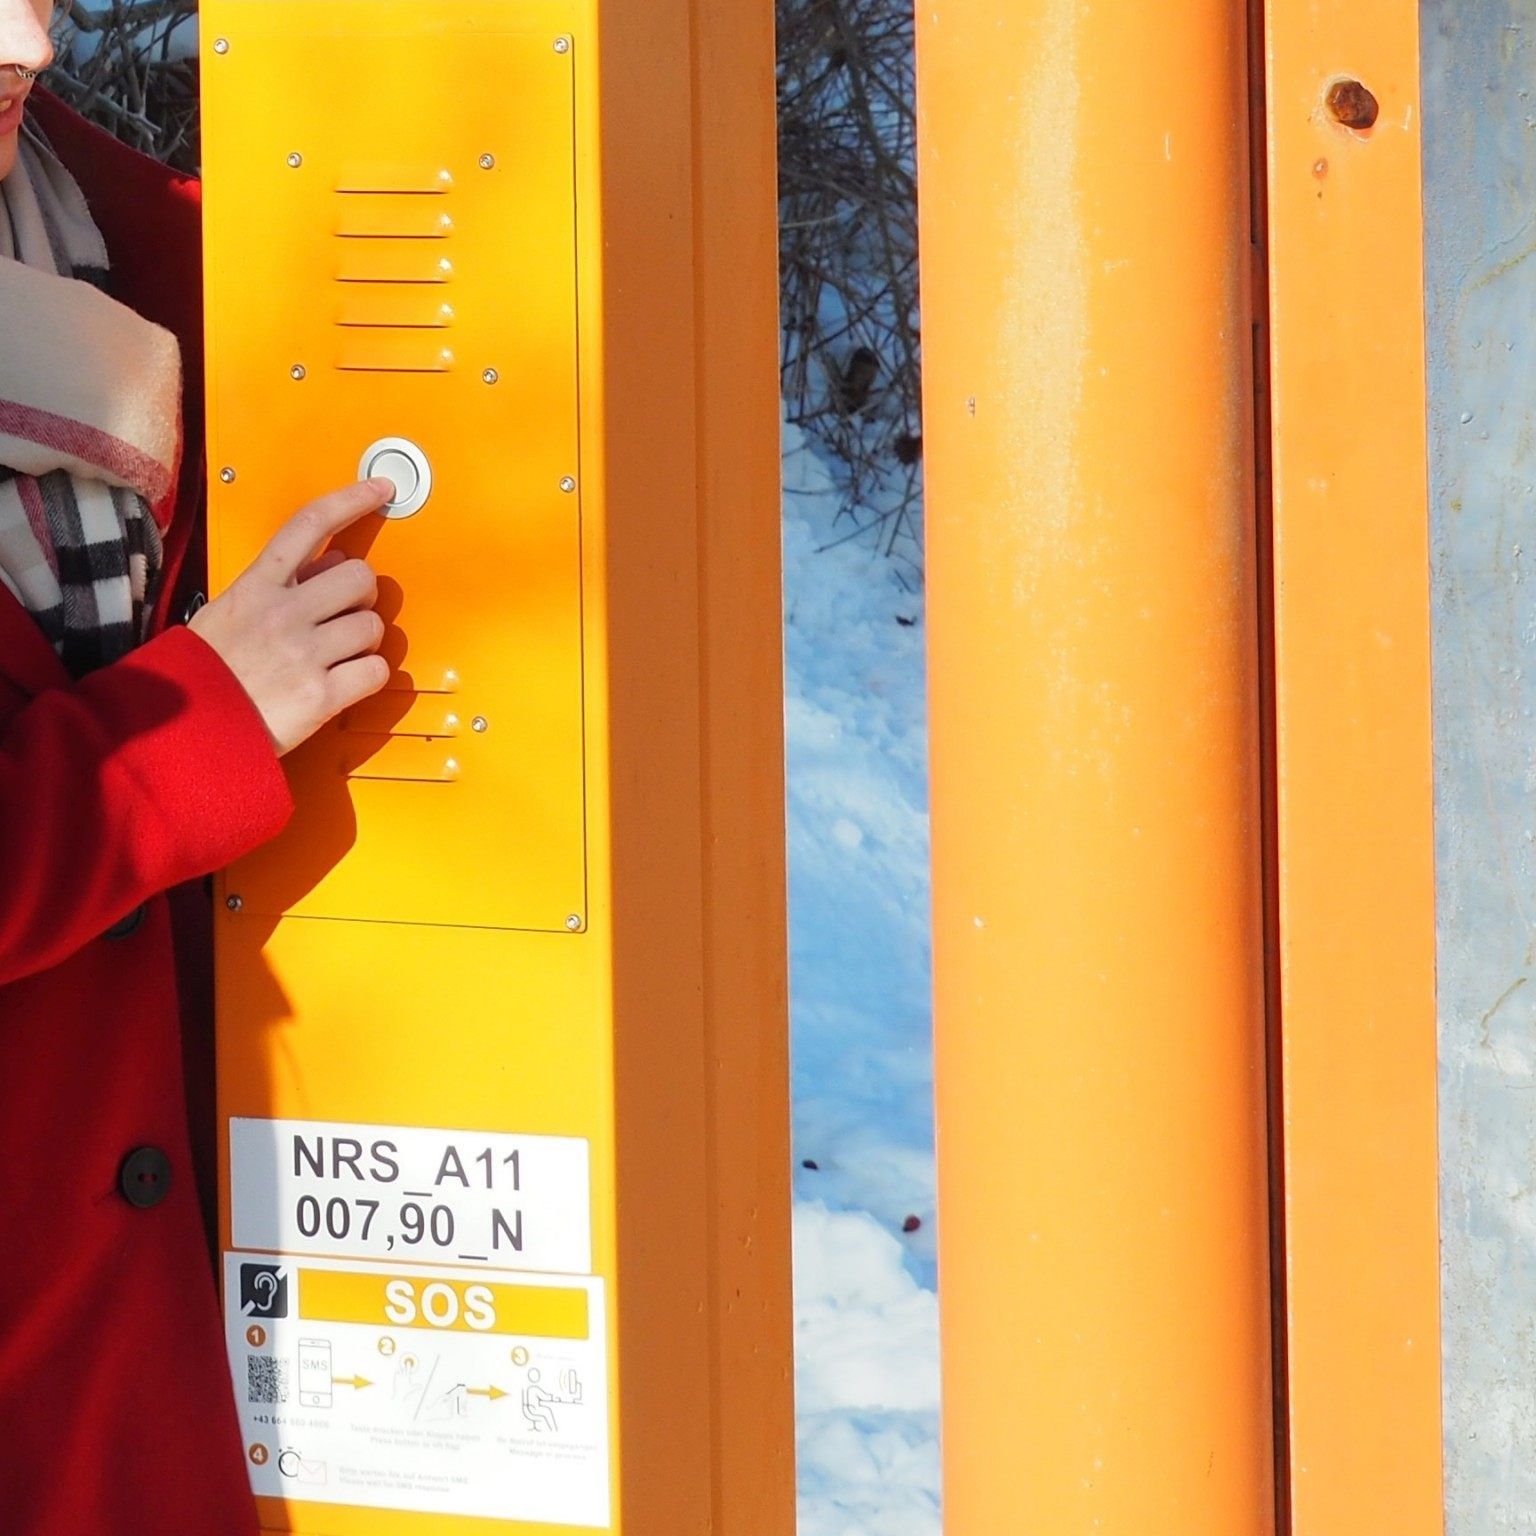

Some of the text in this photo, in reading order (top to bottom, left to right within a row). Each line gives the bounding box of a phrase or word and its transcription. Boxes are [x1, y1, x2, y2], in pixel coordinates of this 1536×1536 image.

[293, 1135, 521, 1197] NRS_A11
[296, 1195, 524, 1261] 007,90_N
[384, 1280, 496, 1331] SOS
[303, 1359, 328, 1371] SMS
